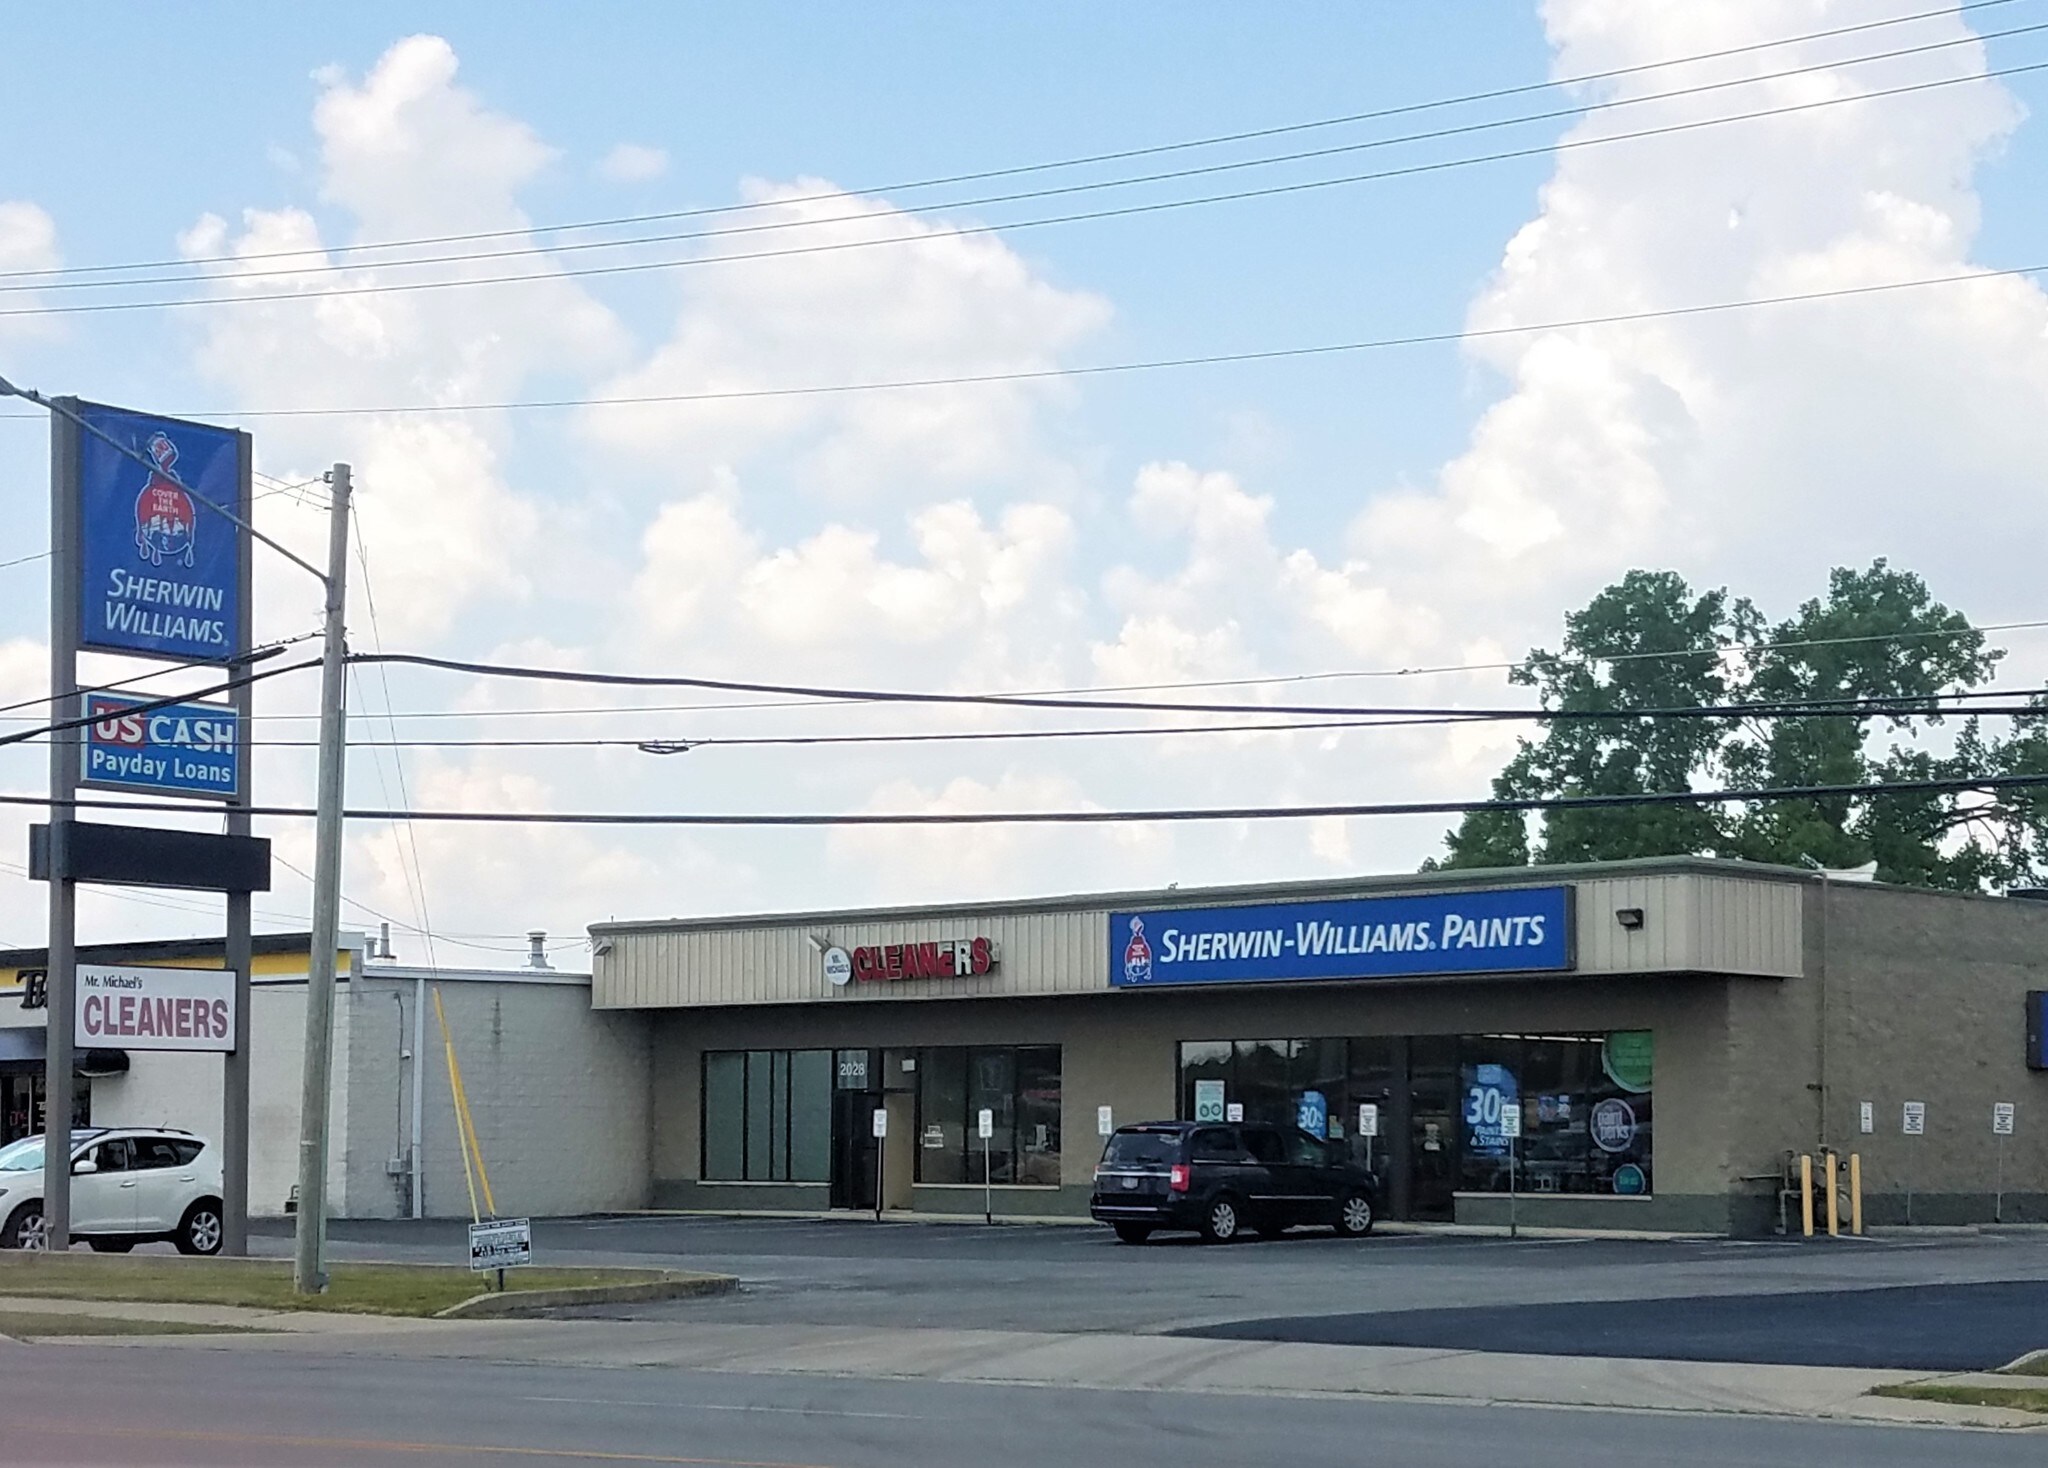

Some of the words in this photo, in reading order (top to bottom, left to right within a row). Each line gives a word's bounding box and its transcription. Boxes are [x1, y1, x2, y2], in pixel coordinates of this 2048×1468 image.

[152, 488, 179, 500] COVER
[152, 503, 179, 515] EARTH
[158, 497, 173, 506] THE
[107, 569, 223, 611] SHERWIN
[106, 603, 223, 644] WILLIAMS
[95, 707, 143, 744] US
[149, 715, 234, 756] CASH
[92, 750, 167, 780] Payday
[174, 758, 231, 783] Loans
[1442, 914, 1546, 950] PAINTS
[853, 936, 992, 982] CLEANERS
[84, 974, 100, 988] Mr.
[102, 975, 143, 990] Michael's
[83, 994, 229, 1039] CLEANERS
[840, 1062, 866, 1077] 2028
